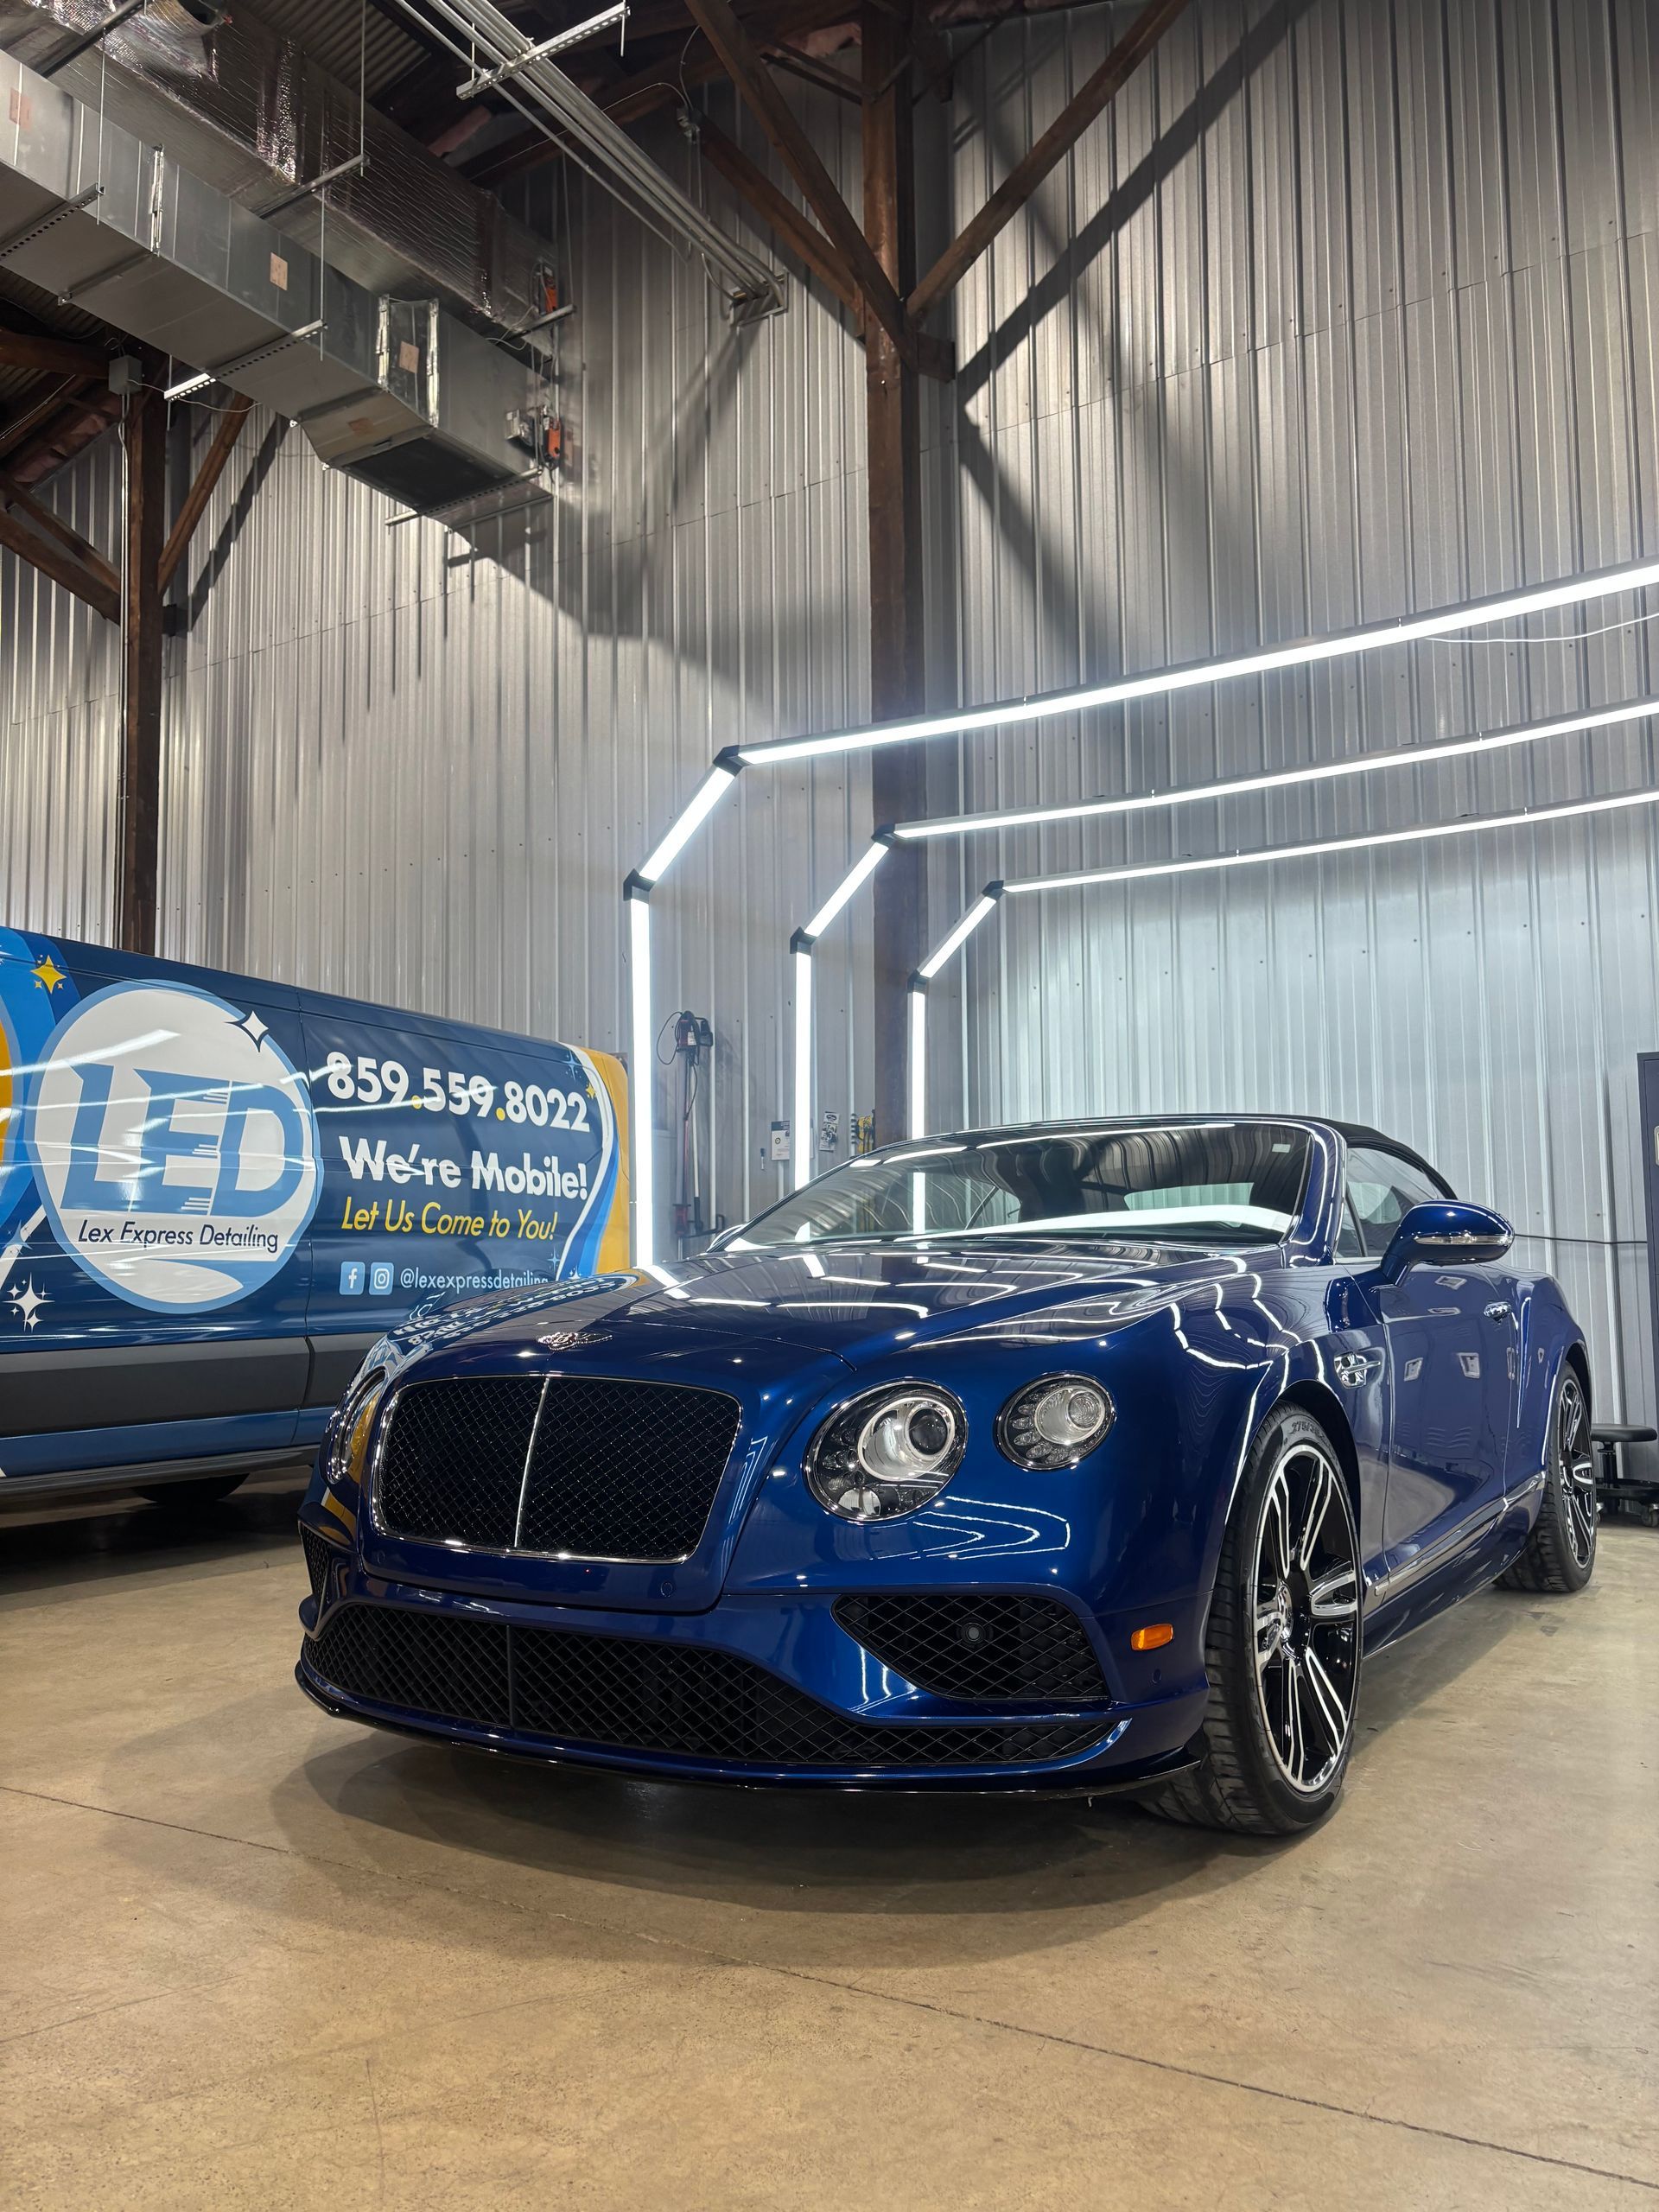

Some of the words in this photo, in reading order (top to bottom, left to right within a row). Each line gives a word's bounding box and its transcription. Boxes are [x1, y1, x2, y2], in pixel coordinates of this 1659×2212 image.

[327, 1052, 590, 1132] 859.559.8022
[60, 1062, 303, 1217] LED
[339, 1135, 461, 1188] We're
[471, 1150, 588, 1200] Mobile!
[78, 1219, 115, 1243] Lex
[119, 1221, 194, 1250] Express
[199, 1224, 278, 1253] Detailing
[341, 1197, 379, 1230] Let
[385, 1199, 415, 1233] Us
[421, 1202, 485, 1236] Come
[488, 1211, 511, 1238] to
[518, 1209, 558, 1241] You!
